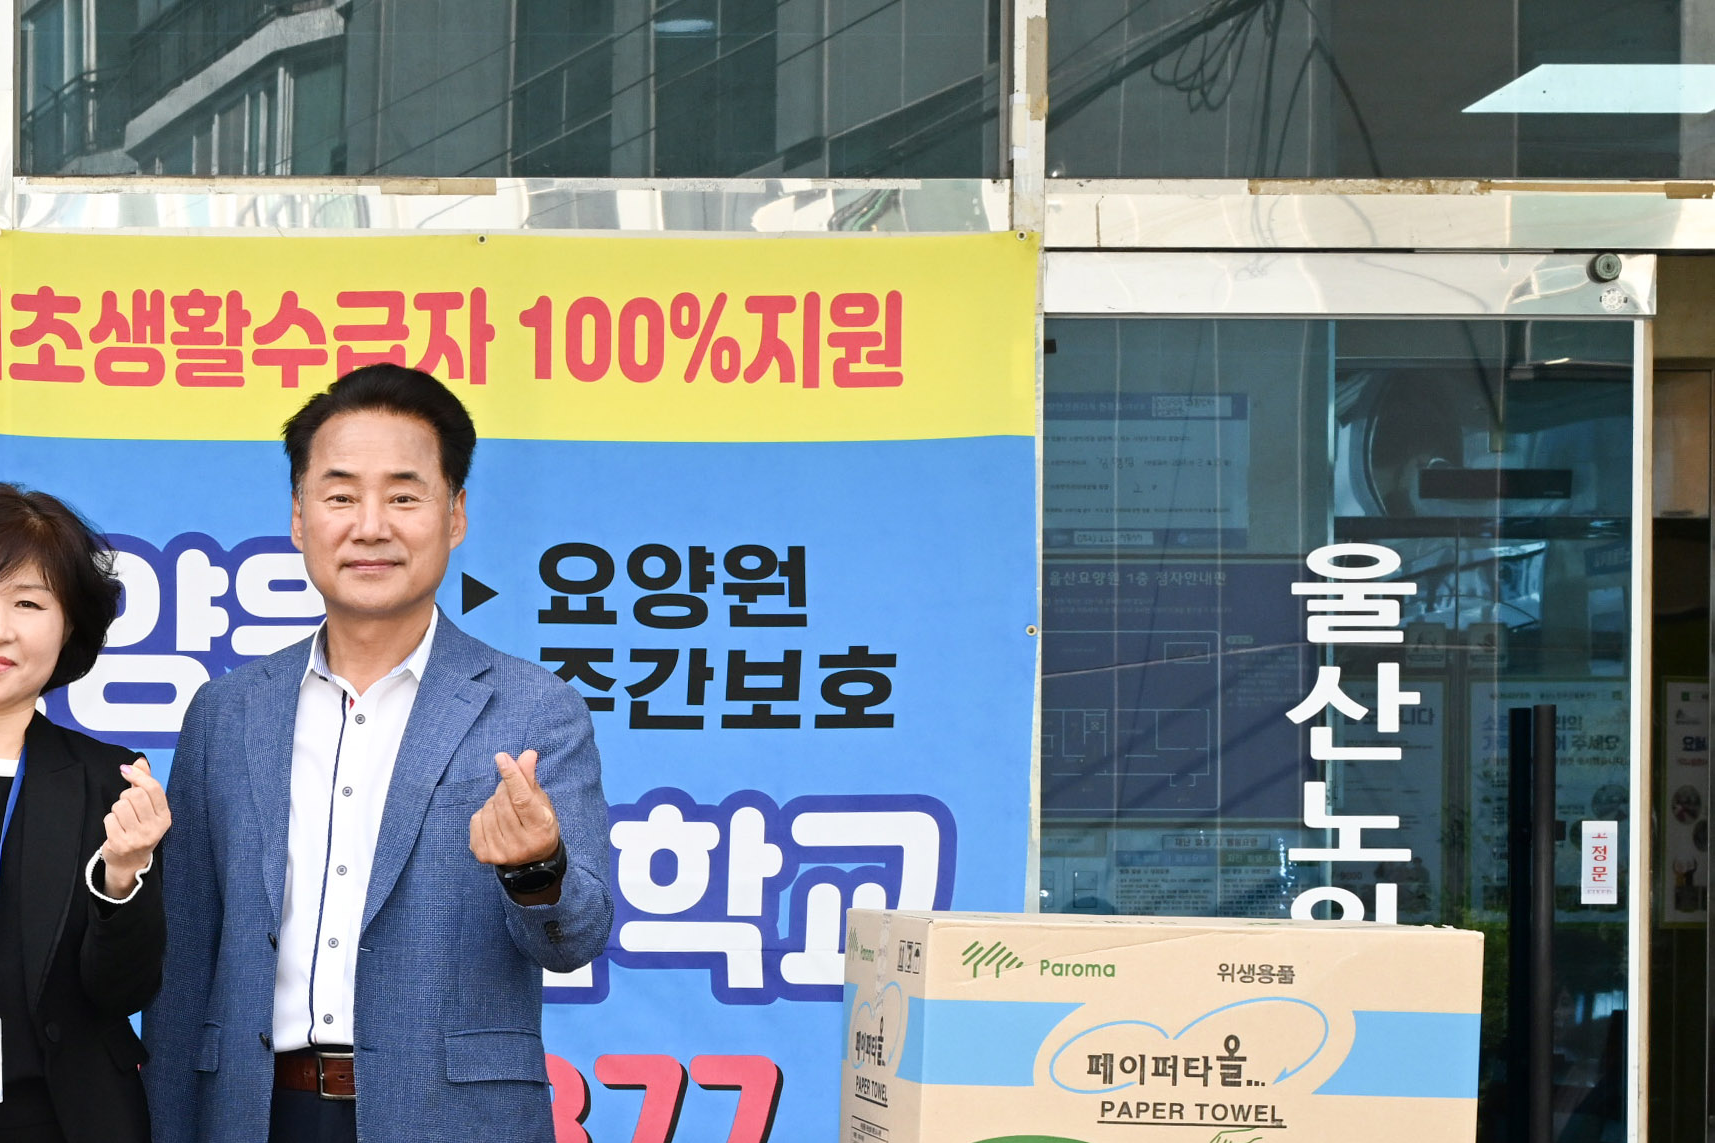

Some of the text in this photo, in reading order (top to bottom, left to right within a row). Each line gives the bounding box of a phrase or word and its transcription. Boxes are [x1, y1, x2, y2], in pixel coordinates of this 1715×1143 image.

[519, 289, 906, 390] 100%지원
[538, 542, 808, 630] 요양원
[539, 645, 897, 730] 주간보호
[543, 804, 940, 989] 학교
[1040, 959, 1116, 978] Paroma
[1216, 963, 1296, 985] 위생용품
[1100, 1101, 1284, 1124] PAPER TOWEL
